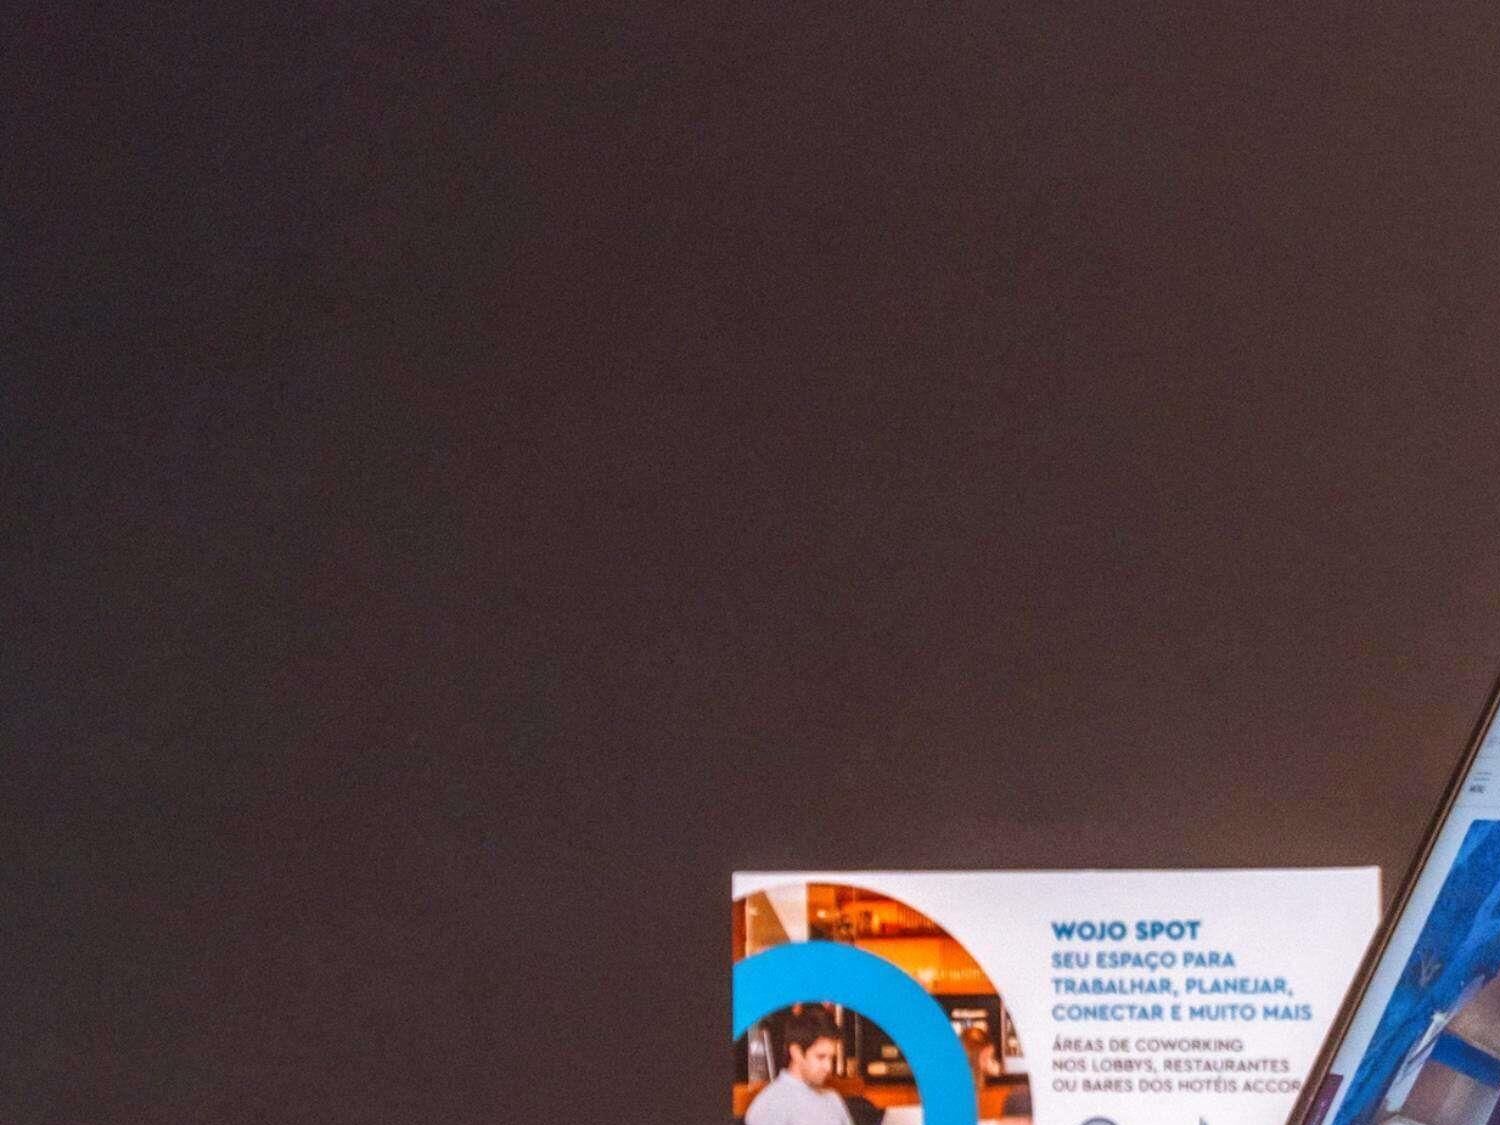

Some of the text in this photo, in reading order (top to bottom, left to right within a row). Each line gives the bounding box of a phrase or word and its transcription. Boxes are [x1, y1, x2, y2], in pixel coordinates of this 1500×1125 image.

[1052, 921, 1201, 941] WOJO SPOT
[1052, 952, 1235, 973] SEU ESPAÇO PARA
[1052, 978, 1294, 998] TRABALHAR, PLANEJAR,
[1052, 1004, 1312, 1022] CONECTAR E MUITO MAIS
[1052, 1034, 1243, 1053] ÁREAS DE COWORKING
[1052, 1059, 1290, 1075] NOS LOBBYS, RESTAURANTES
[1052, 1077, 1302, 1093] OU BARES DOS HOTÉIS ACCOR
